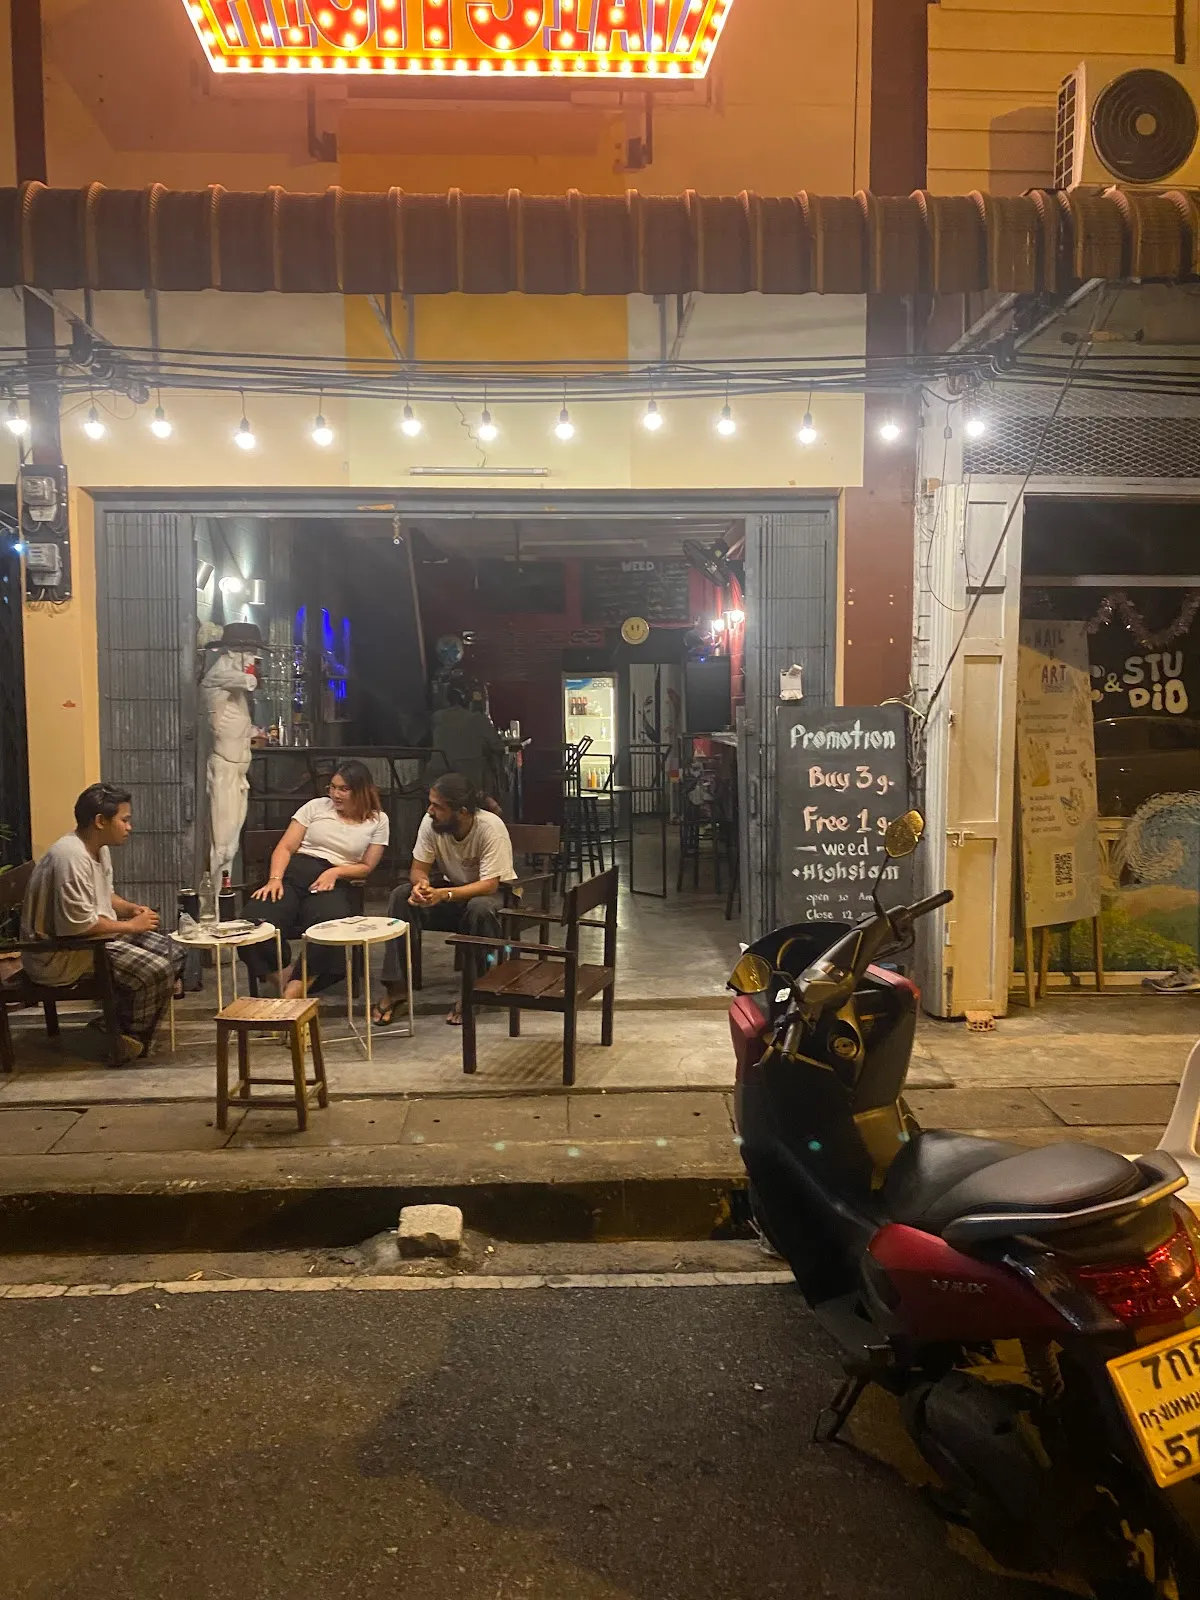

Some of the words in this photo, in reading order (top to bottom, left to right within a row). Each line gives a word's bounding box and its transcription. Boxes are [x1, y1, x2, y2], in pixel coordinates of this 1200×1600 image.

[621, 561, 655, 572] WEED
[1041, 664, 1066, 684] ART
[1104, 672, 1124, 693] &
[1122, 650, 1183, 685] STU
[790, 719, 896, 750] Promotion
[808, 765, 850, 793] Buy
[855, 765, 874, 789] 3
[803, 805, 850, 834] Free
[856, 808, 873, 834] 1
[821, 837, 869, 856] weed
[806, 893, 830, 907] open
[806, 908, 834, 920] Close
[842, 909, 853, 920] 12
